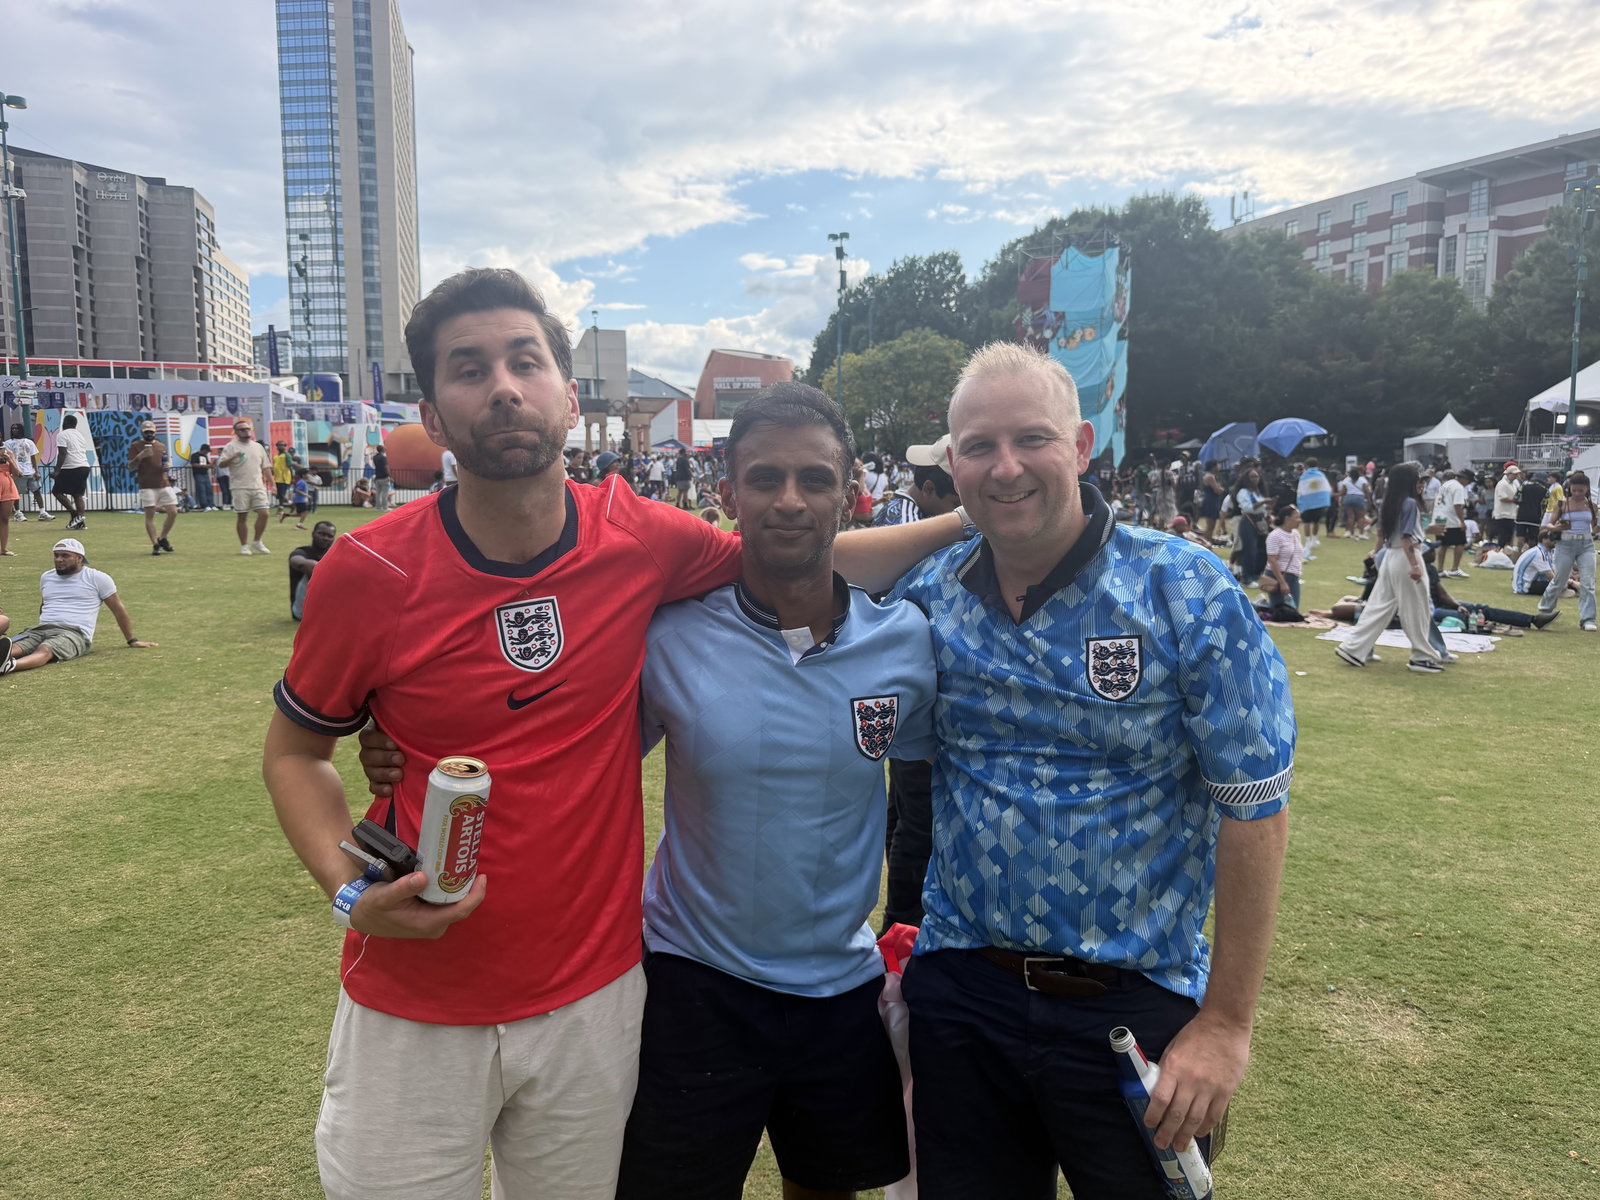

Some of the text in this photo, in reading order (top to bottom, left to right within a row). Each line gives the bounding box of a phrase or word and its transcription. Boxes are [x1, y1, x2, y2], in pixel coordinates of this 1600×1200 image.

[95, 190, 130, 200] HOTEL
[54, 380, 94, 390] ULTRA
[454, 814, 475, 874] ARTOIS
[468, 810, 485, 871] STELLA
